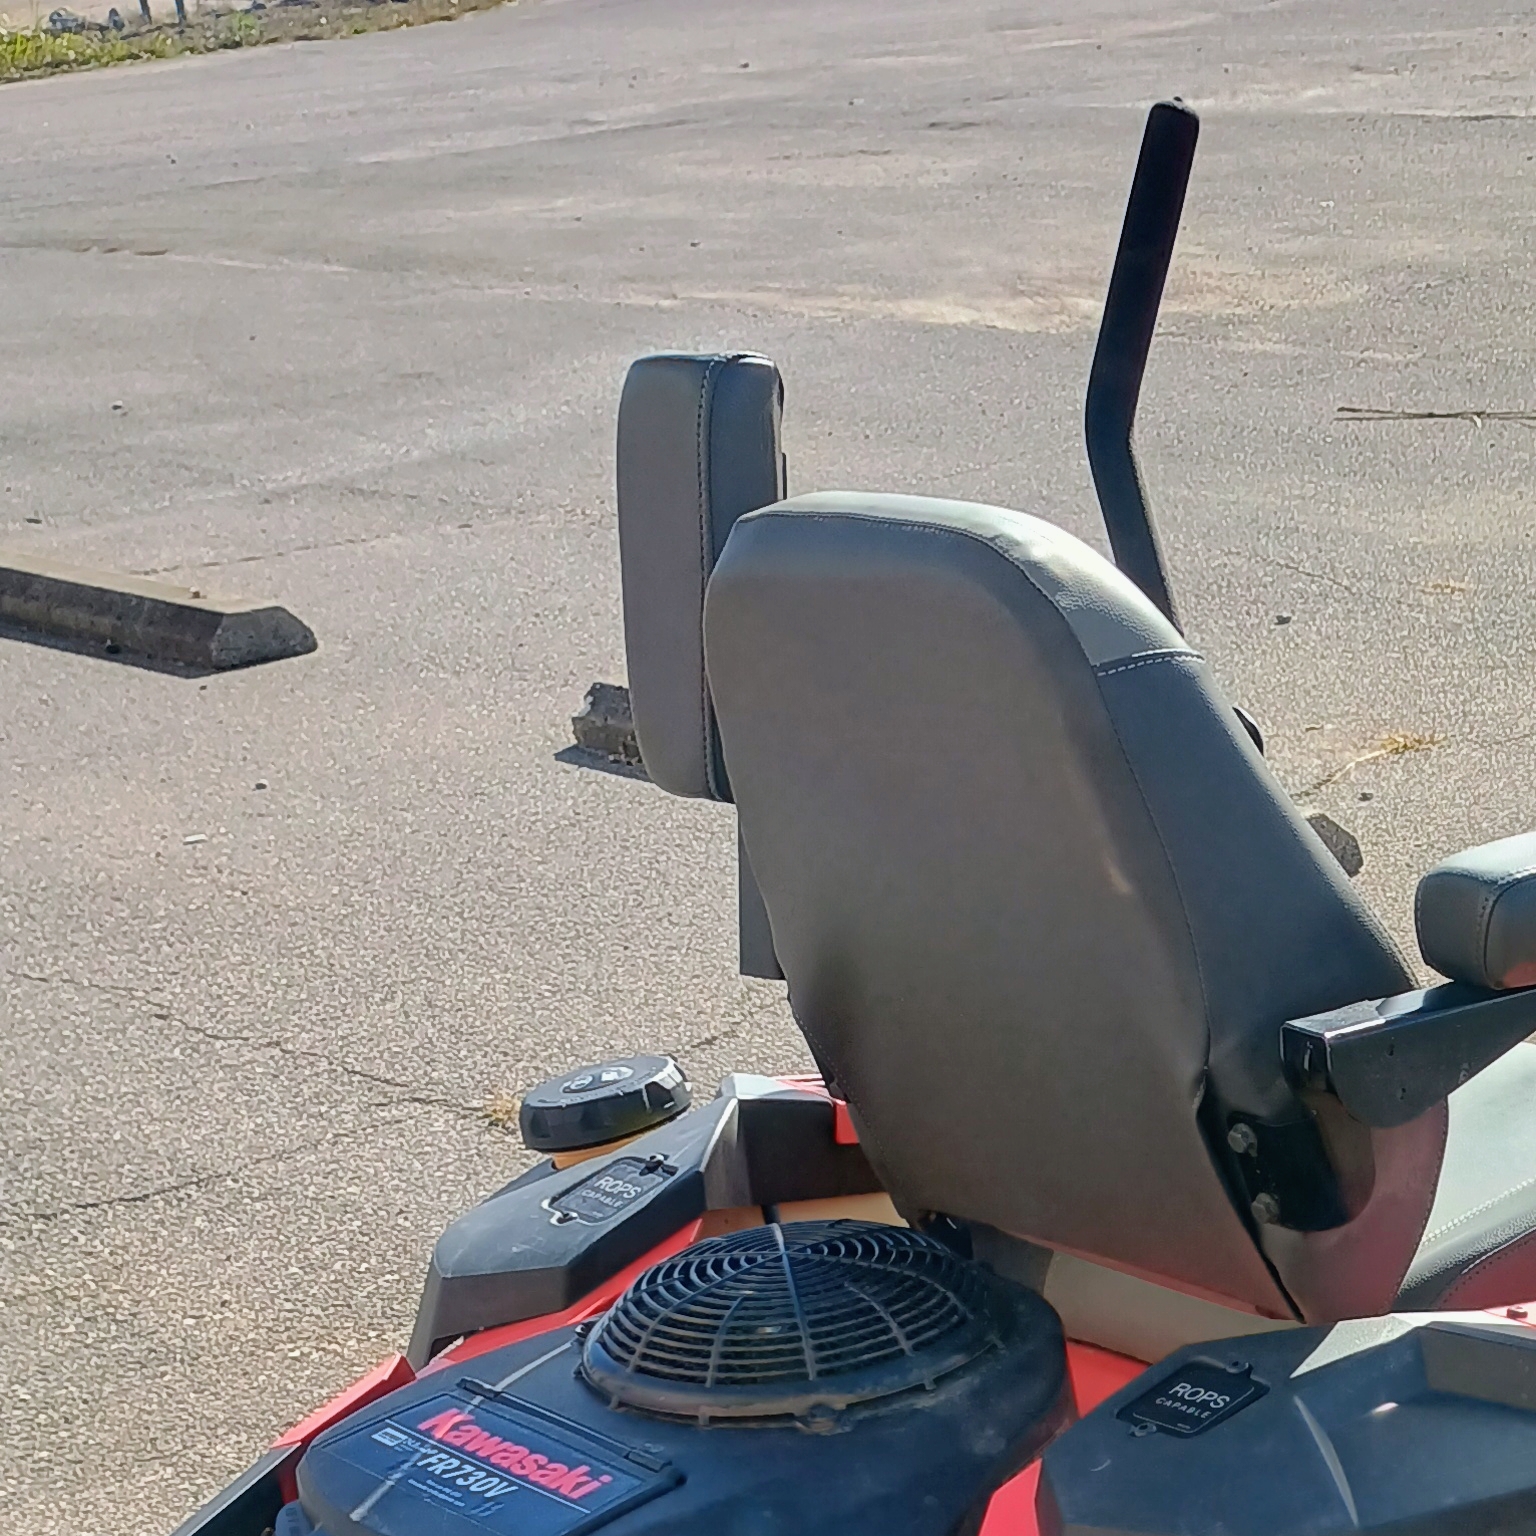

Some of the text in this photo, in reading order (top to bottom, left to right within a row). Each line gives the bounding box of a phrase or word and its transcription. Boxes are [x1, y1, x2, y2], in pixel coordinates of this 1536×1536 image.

[581, 1189, 624, 1208] CAPABLE
[594, 1176, 642, 1199] ROPS
[1155, 1397, 1213, 1419] CAPABLE
[1168, 1382, 1231, 1409] ROPS
[417, 1408, 613, 1500] Kawasaki
[416, 1450, 520, 1499] FR730V
